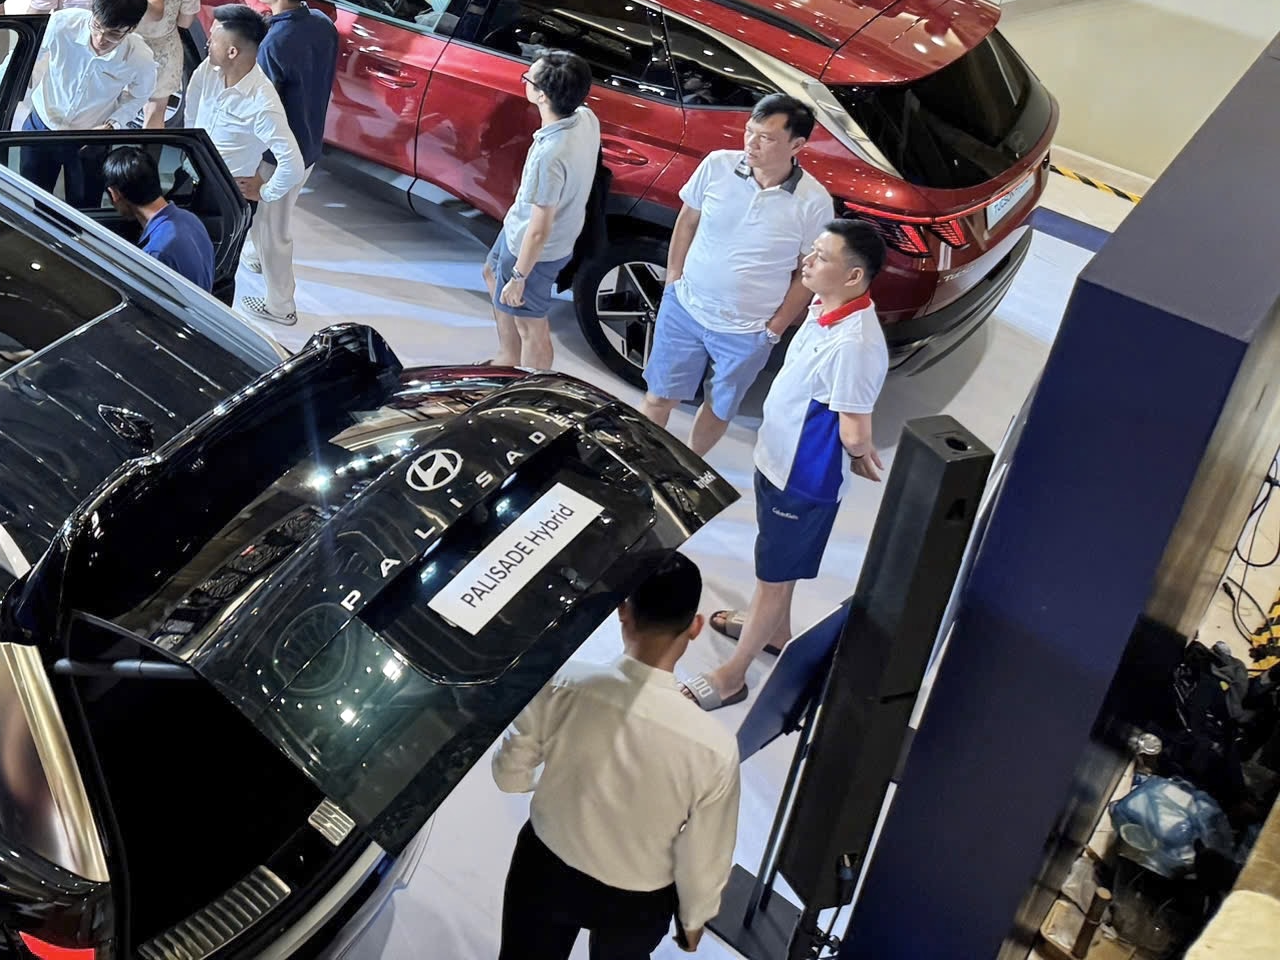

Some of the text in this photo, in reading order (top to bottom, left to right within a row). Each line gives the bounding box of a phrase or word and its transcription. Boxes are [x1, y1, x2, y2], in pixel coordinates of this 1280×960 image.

[340, 415, 573, 612] PALISADE
[460, 503, 575, 608] PALISADE Hybrid
